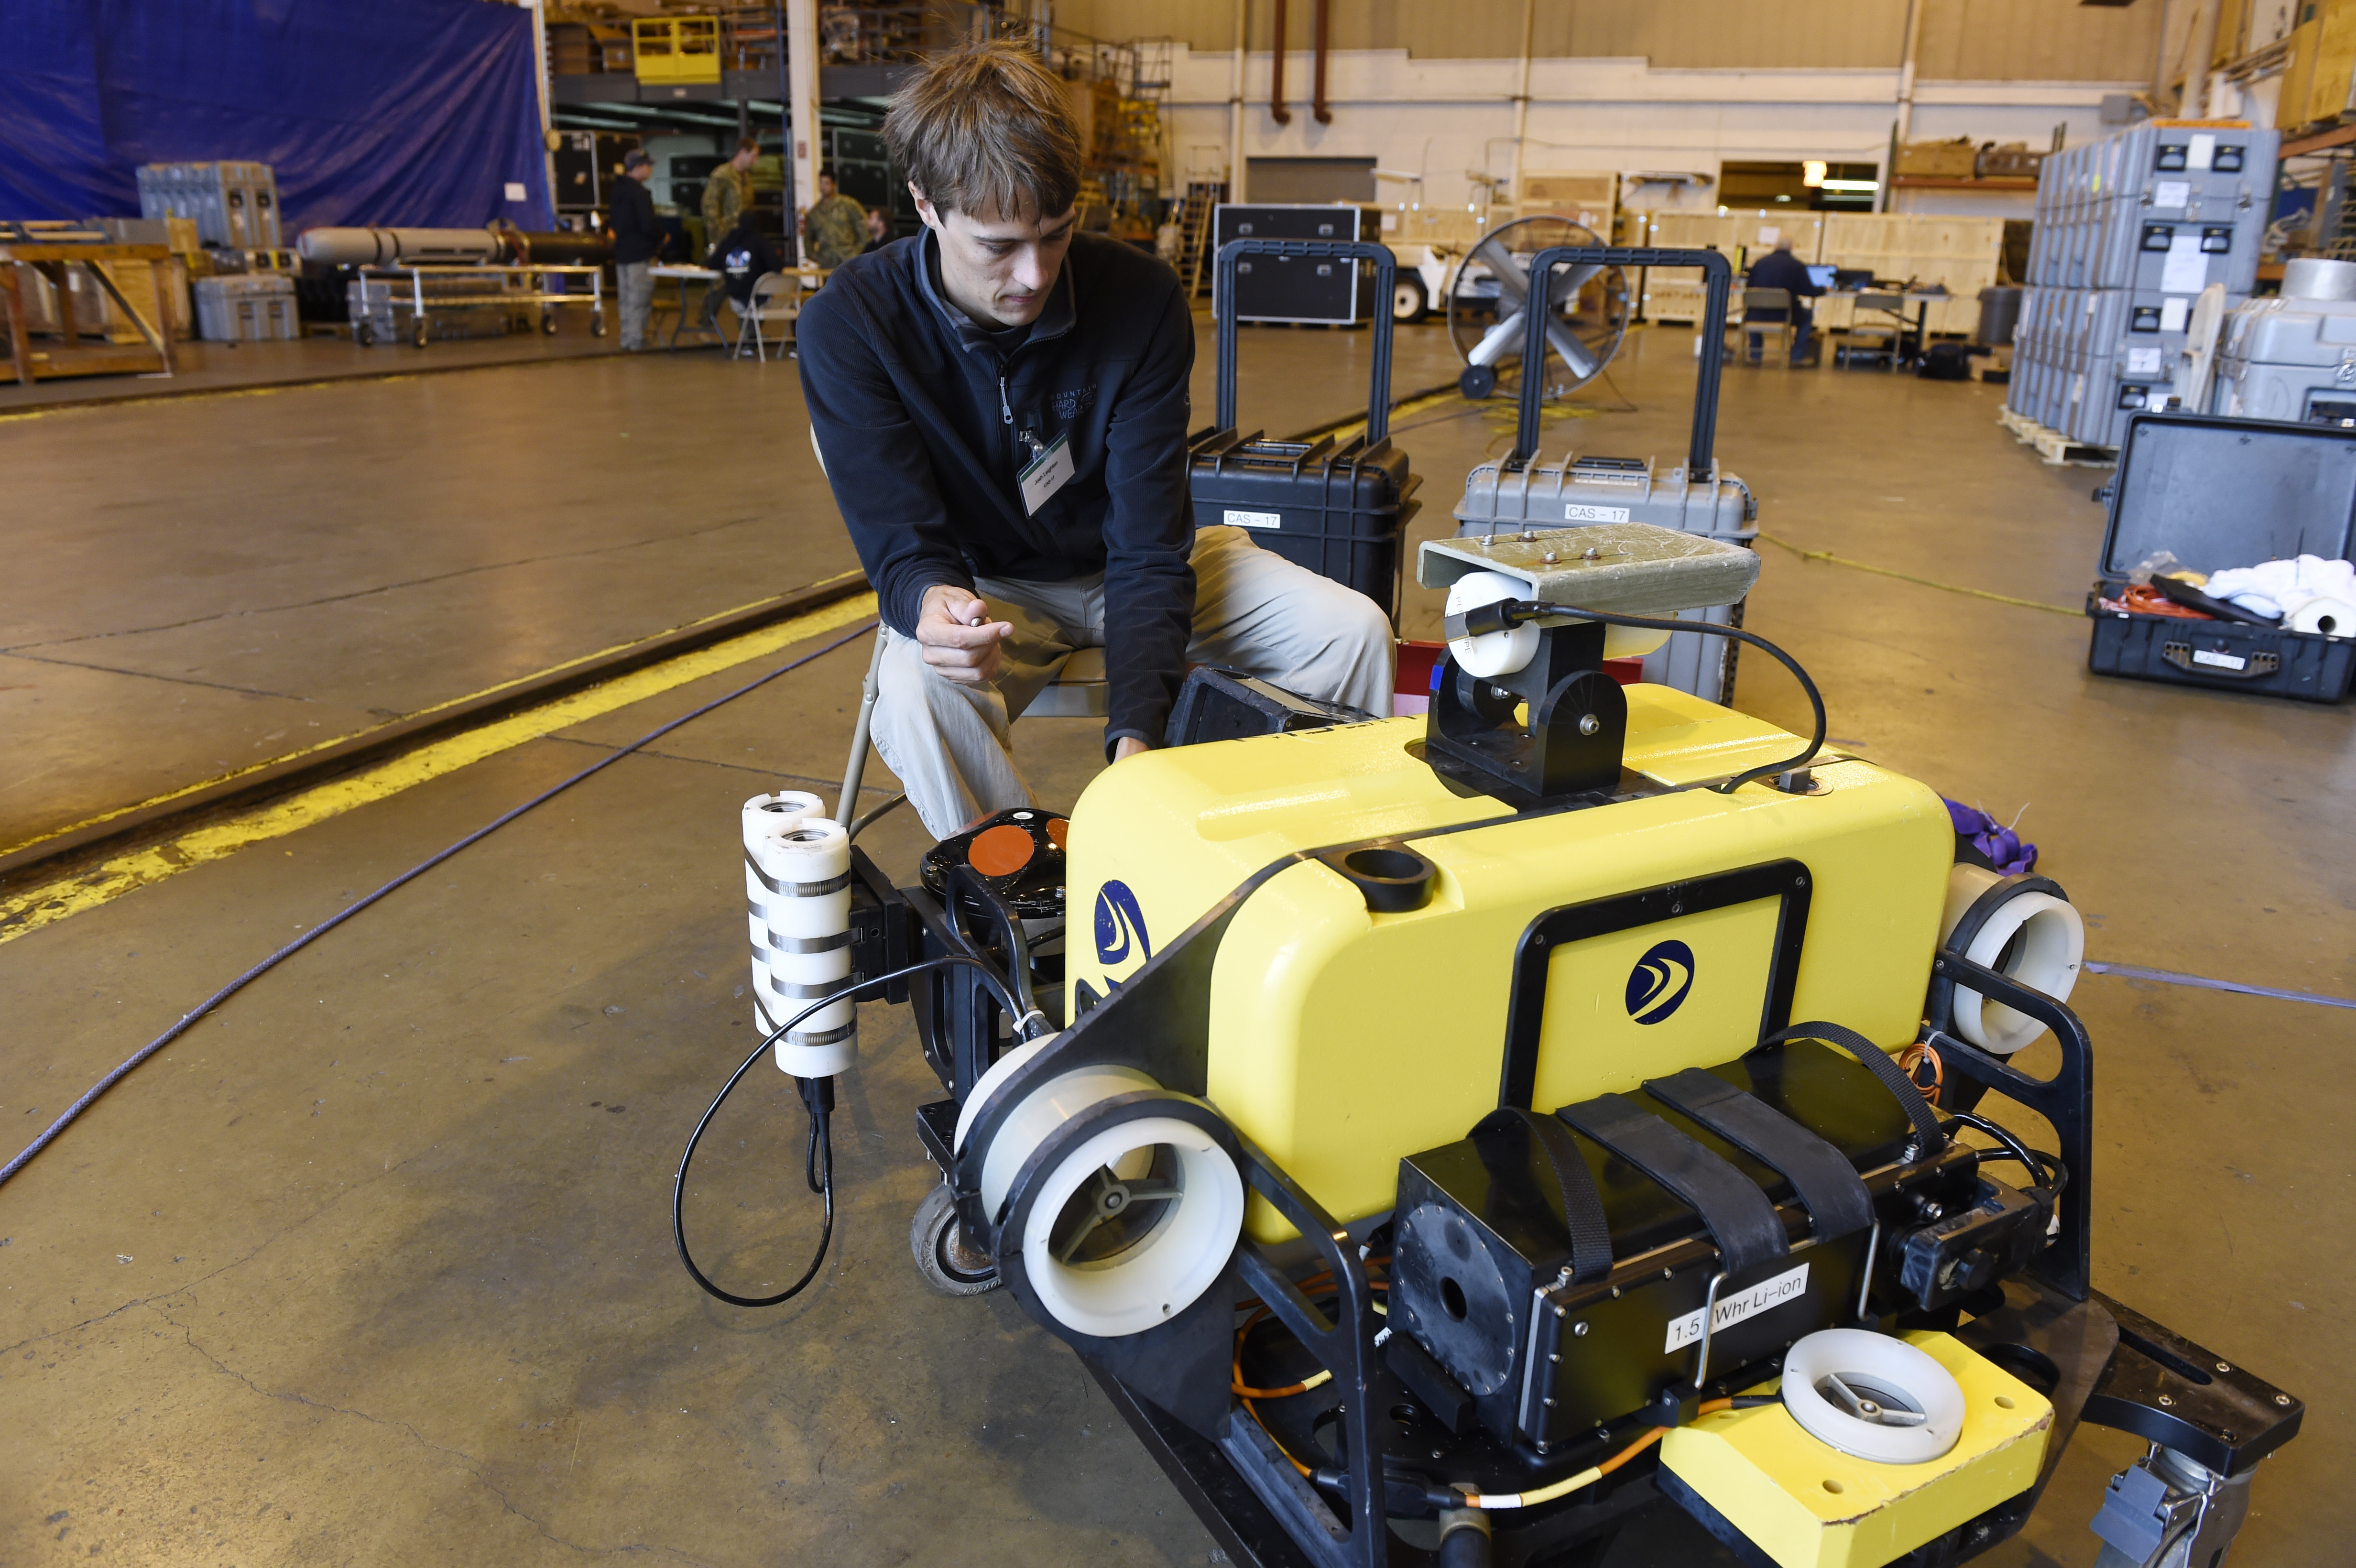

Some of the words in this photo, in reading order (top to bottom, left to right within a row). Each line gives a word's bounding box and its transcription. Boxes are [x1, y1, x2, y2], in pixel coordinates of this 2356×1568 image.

[1052, 398, 1076, 412] HARD
[1058, 405, 1084, 420] WEAR
[1227, 513, 1251, 524] CAS
[1265, 516, 1277, 526] 17
[1569, 507, 1596, 519] CAS
[1612, 510, 1626, 521] 17
[1675, 1317, 1700, 1341] 1.5
[1754, 1277, 1801, 1308] Li-ion
